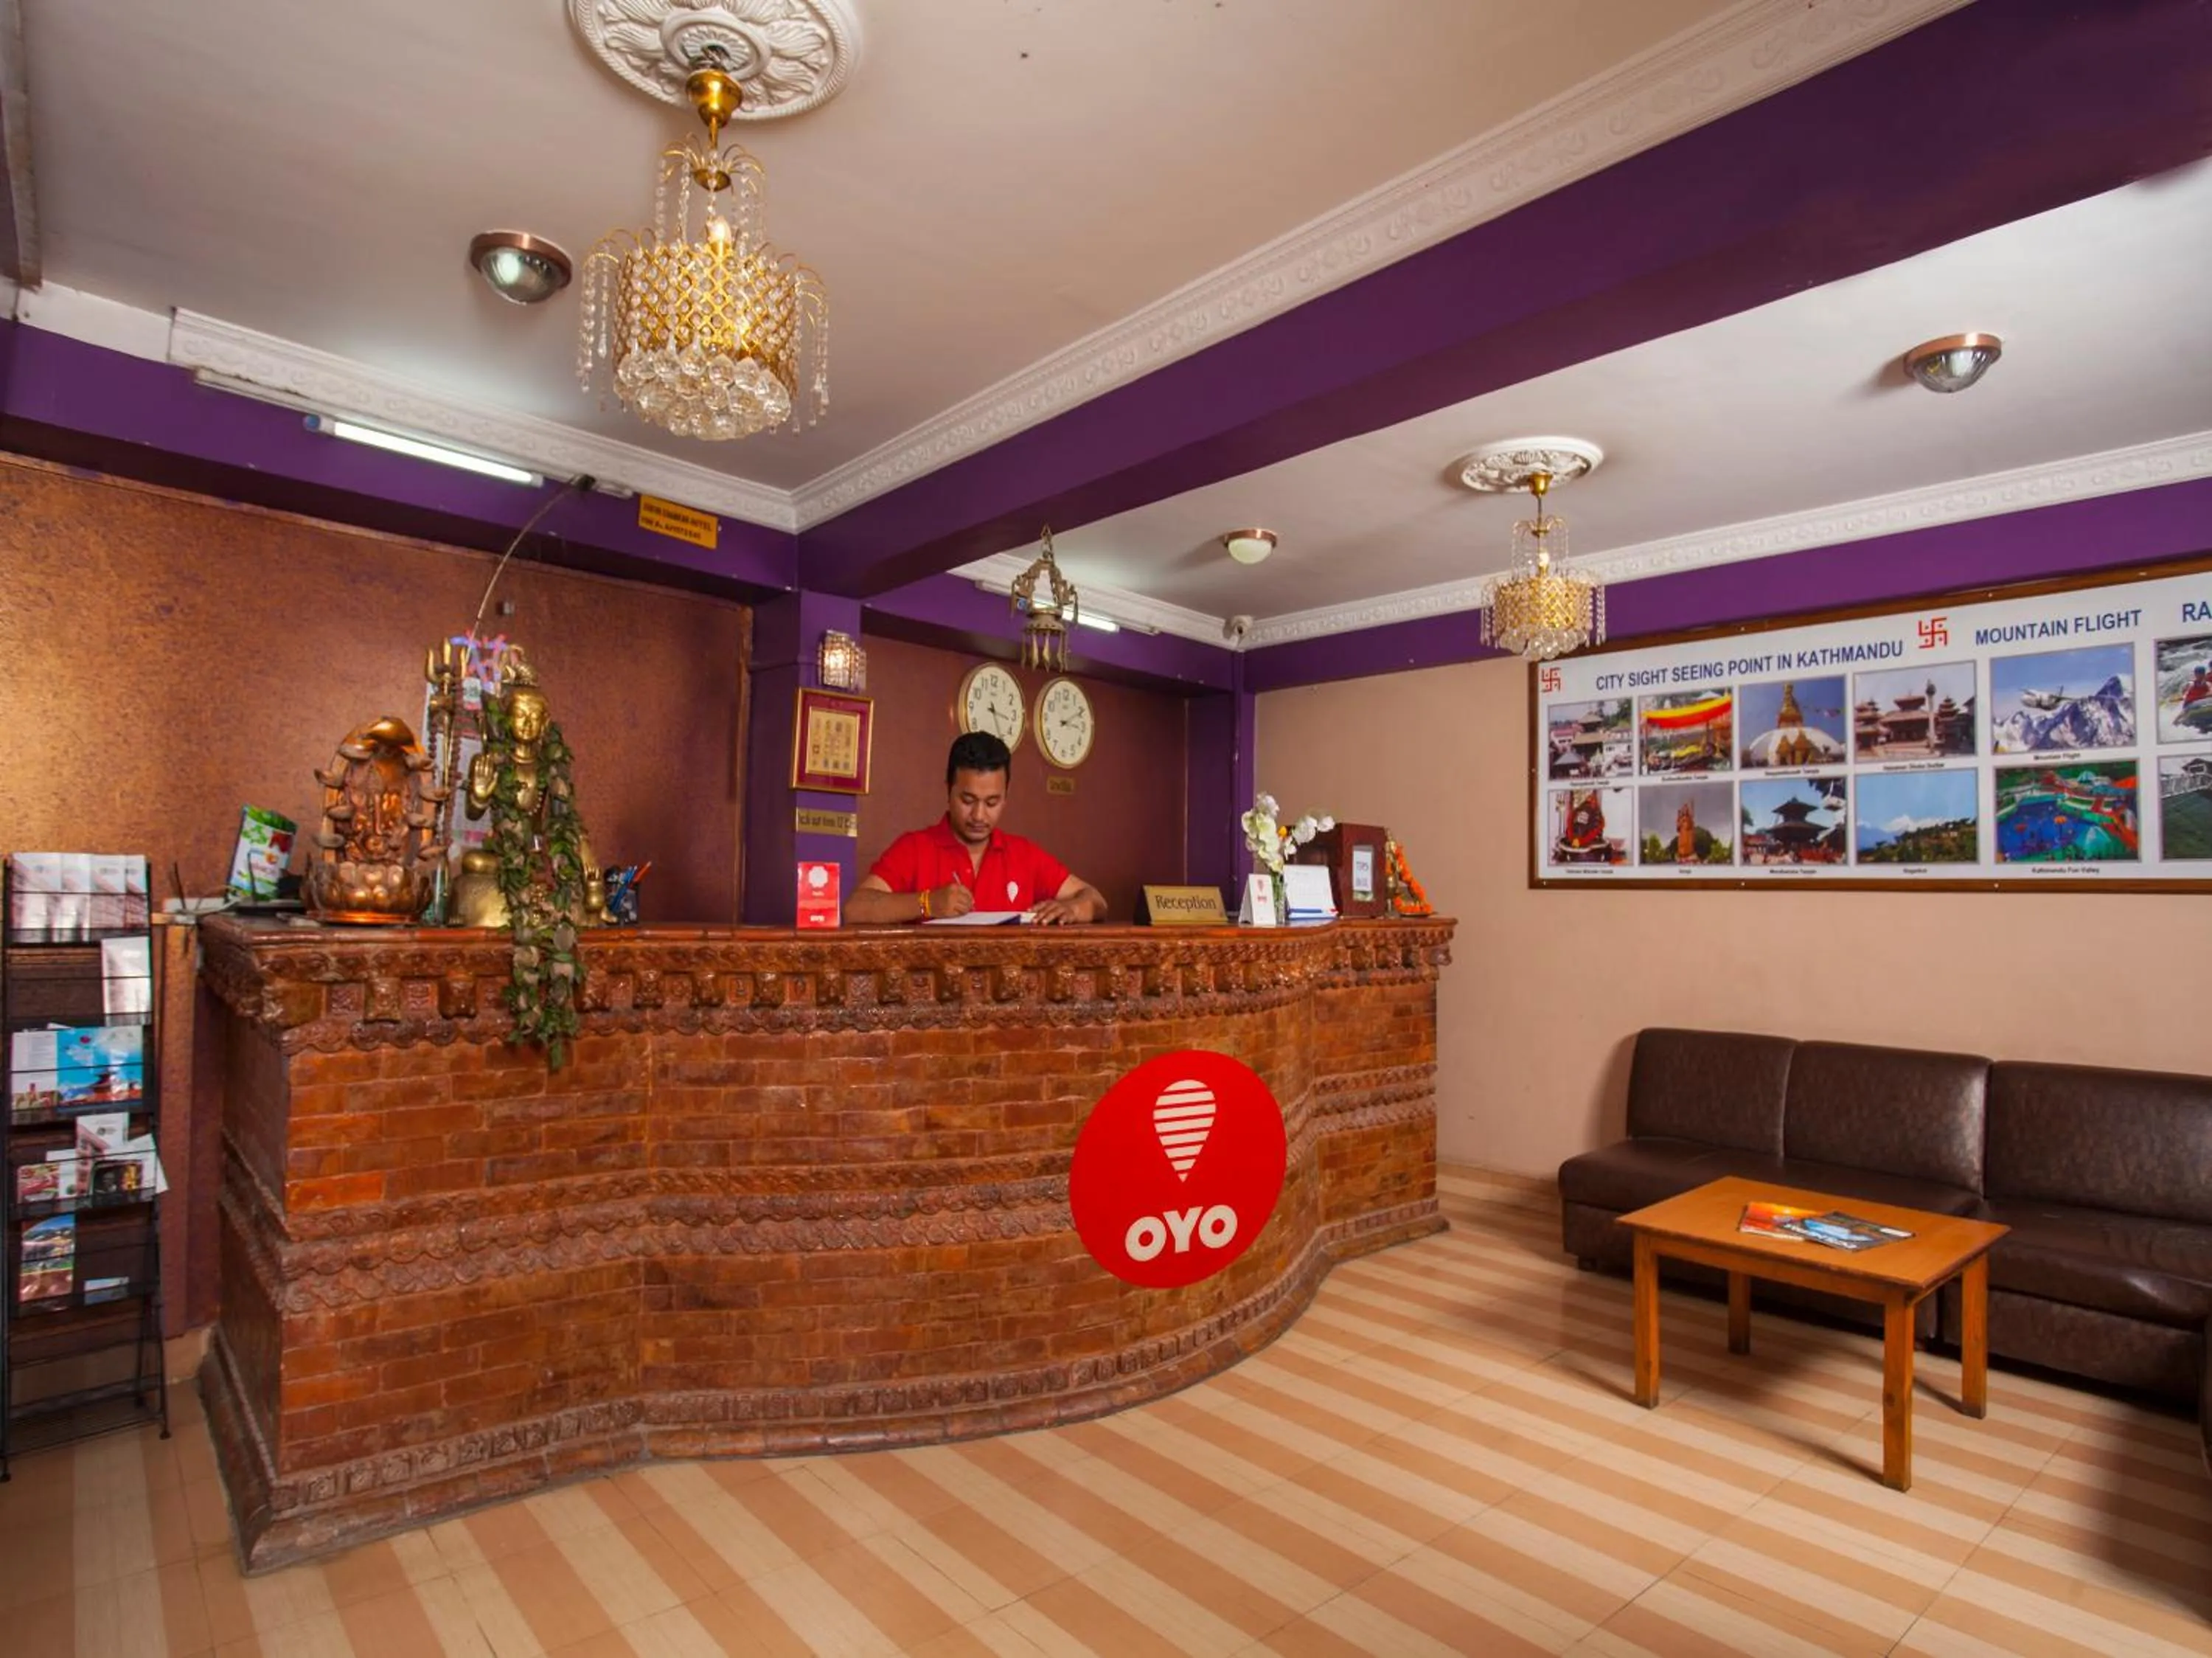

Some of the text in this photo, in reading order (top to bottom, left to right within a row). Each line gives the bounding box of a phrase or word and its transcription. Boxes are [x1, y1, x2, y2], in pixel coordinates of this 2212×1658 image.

[1975, 609, 2142, 645] MOUNTAIN FLIGHT
[990, 674, 998, 687] 12
[1596, 639, 1903, 690] CITY SIGHT SEEING POINT IN KATHMANDU
[1155, 895, 1217, 913] Reception
[1125, 1204, 1238, 1262] OYO
